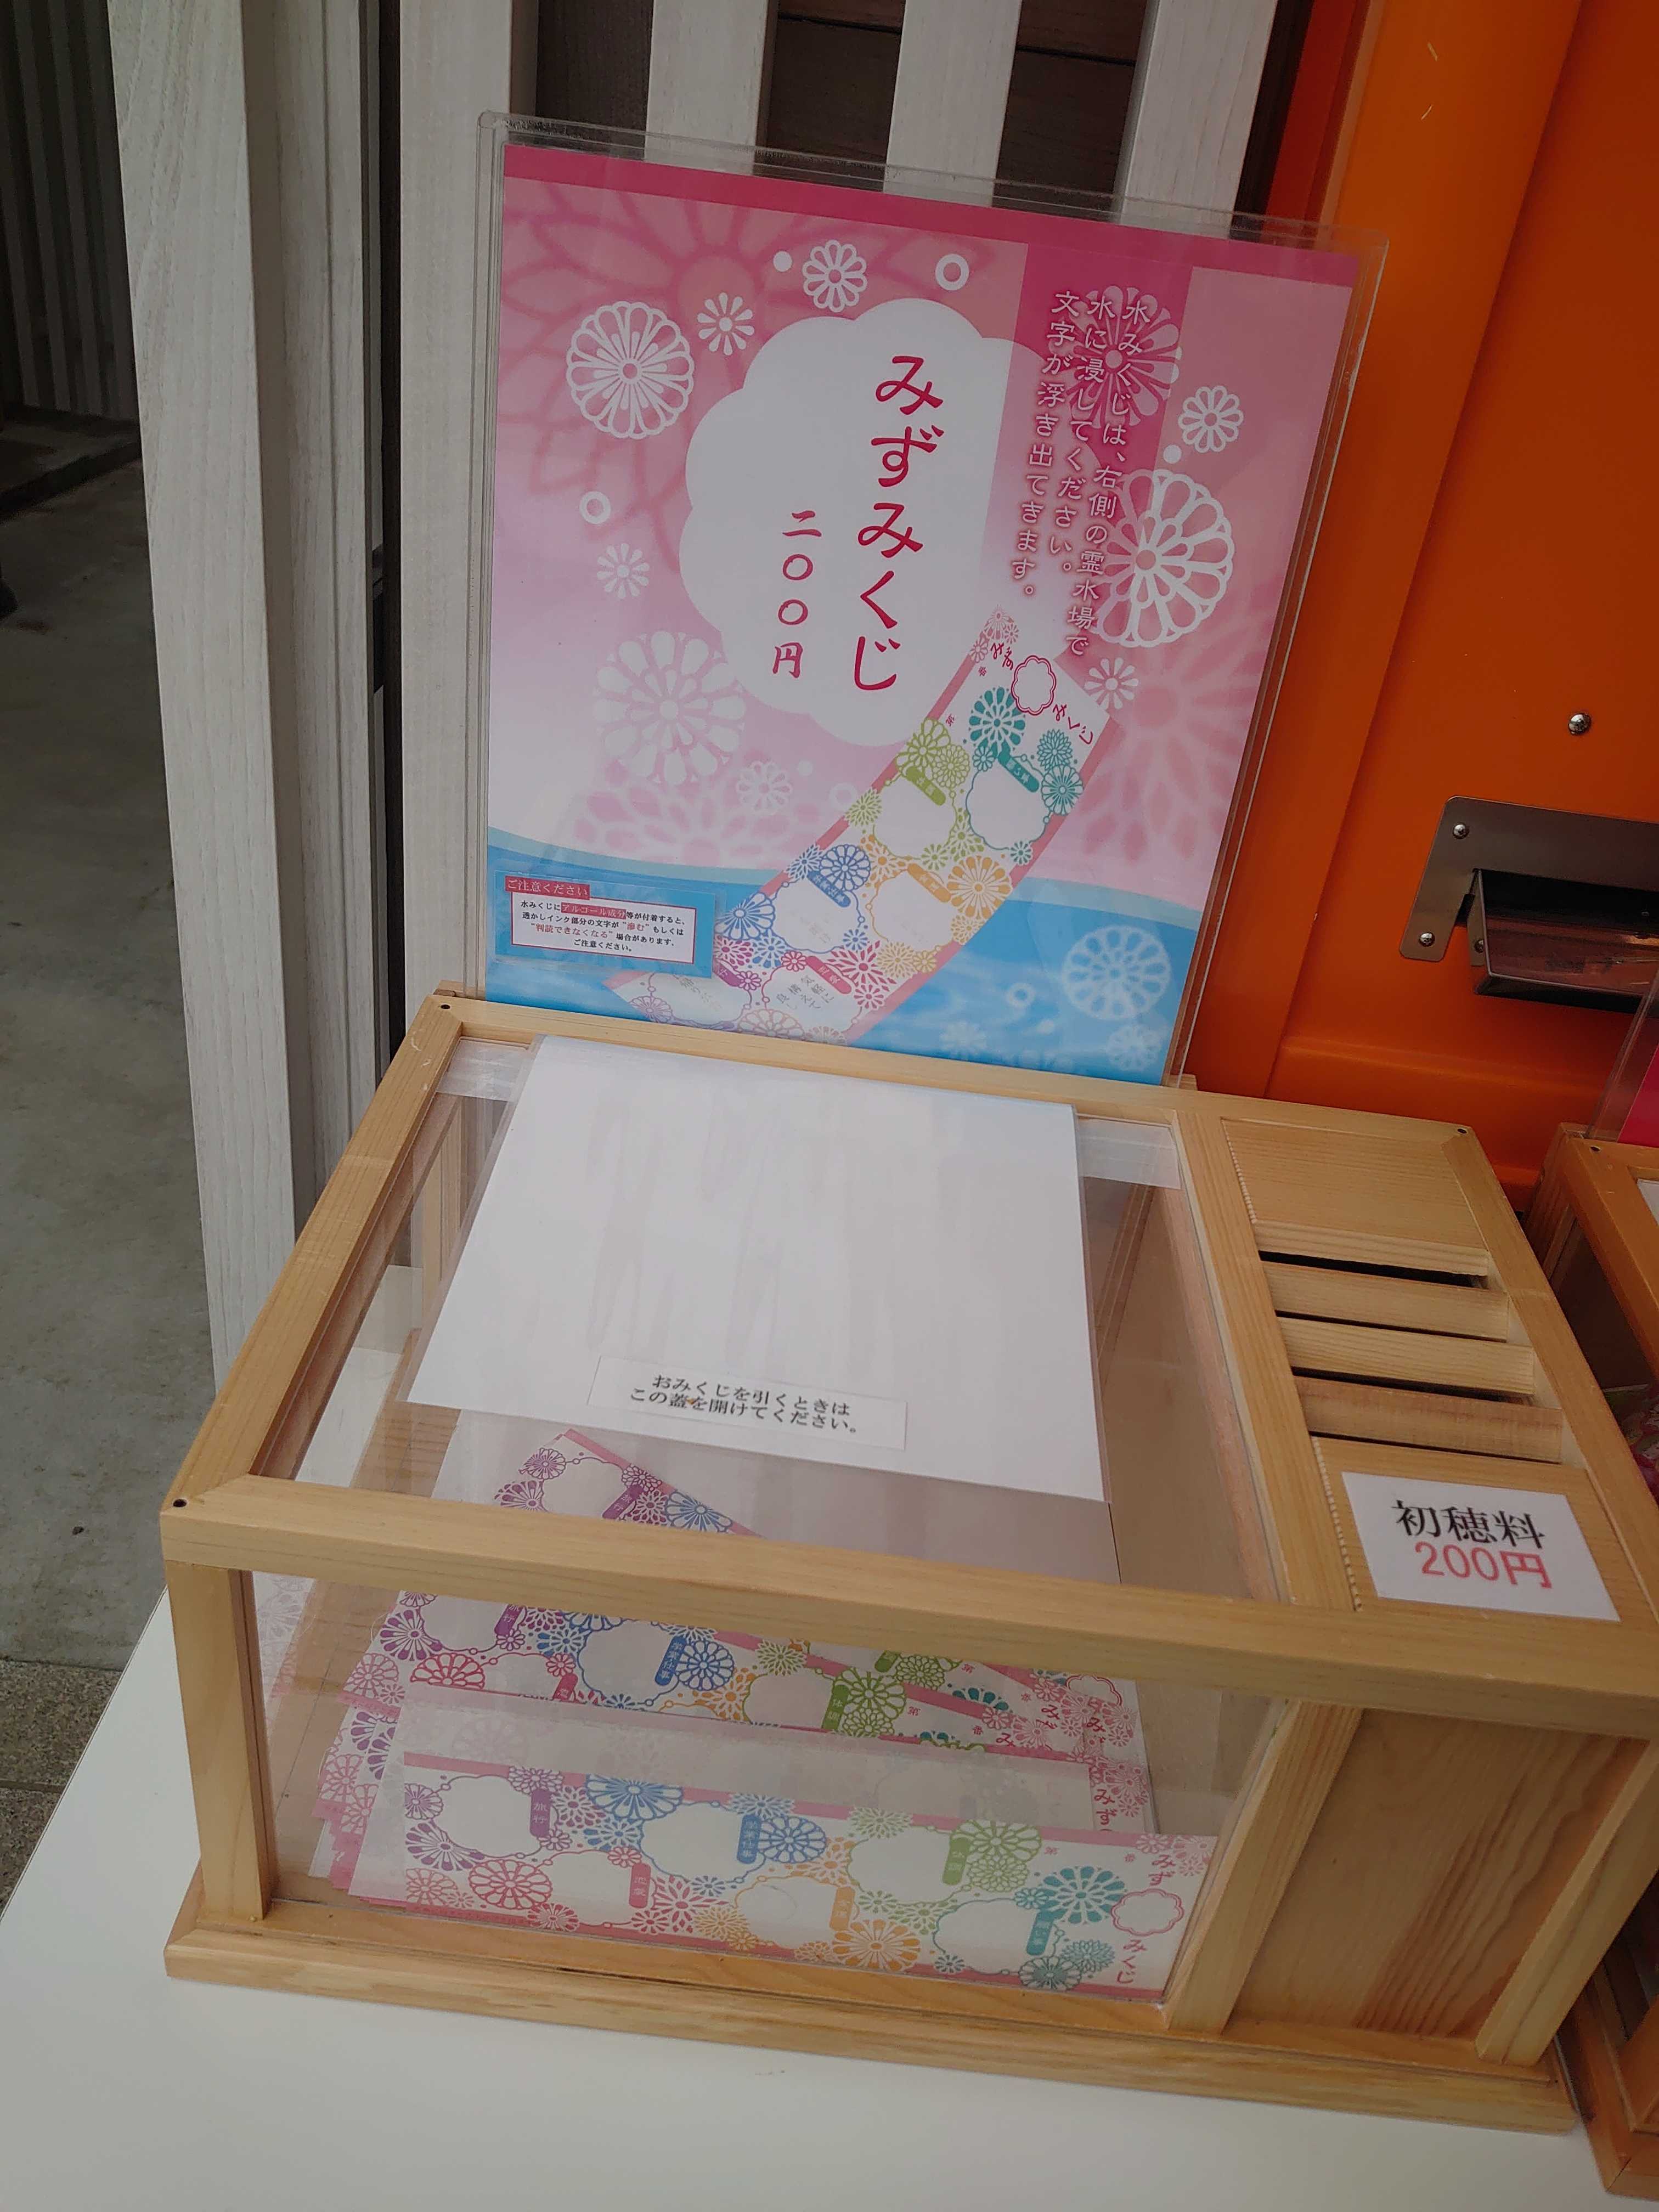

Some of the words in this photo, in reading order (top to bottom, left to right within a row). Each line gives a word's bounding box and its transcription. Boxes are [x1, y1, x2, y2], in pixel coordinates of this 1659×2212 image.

[1012, 290, 1081, 596] 文字が浮き出てきます。
[1048, 297, 1117, 572] 水に浸してください。
[853, 355, 945, 691] みずみくじ
[507, 879, 589, 896] ご注意ください
[574, 939, 632, 952] ご注意ください。
[630, 1387, 856, 1434] この蓋を開けてください。
[652, 1374, 851, 1416] おみくじを引くときは
[1391, 1499, 1545, 1549] 初穂料
[1415, 1541, 1553, 1589] 200円
